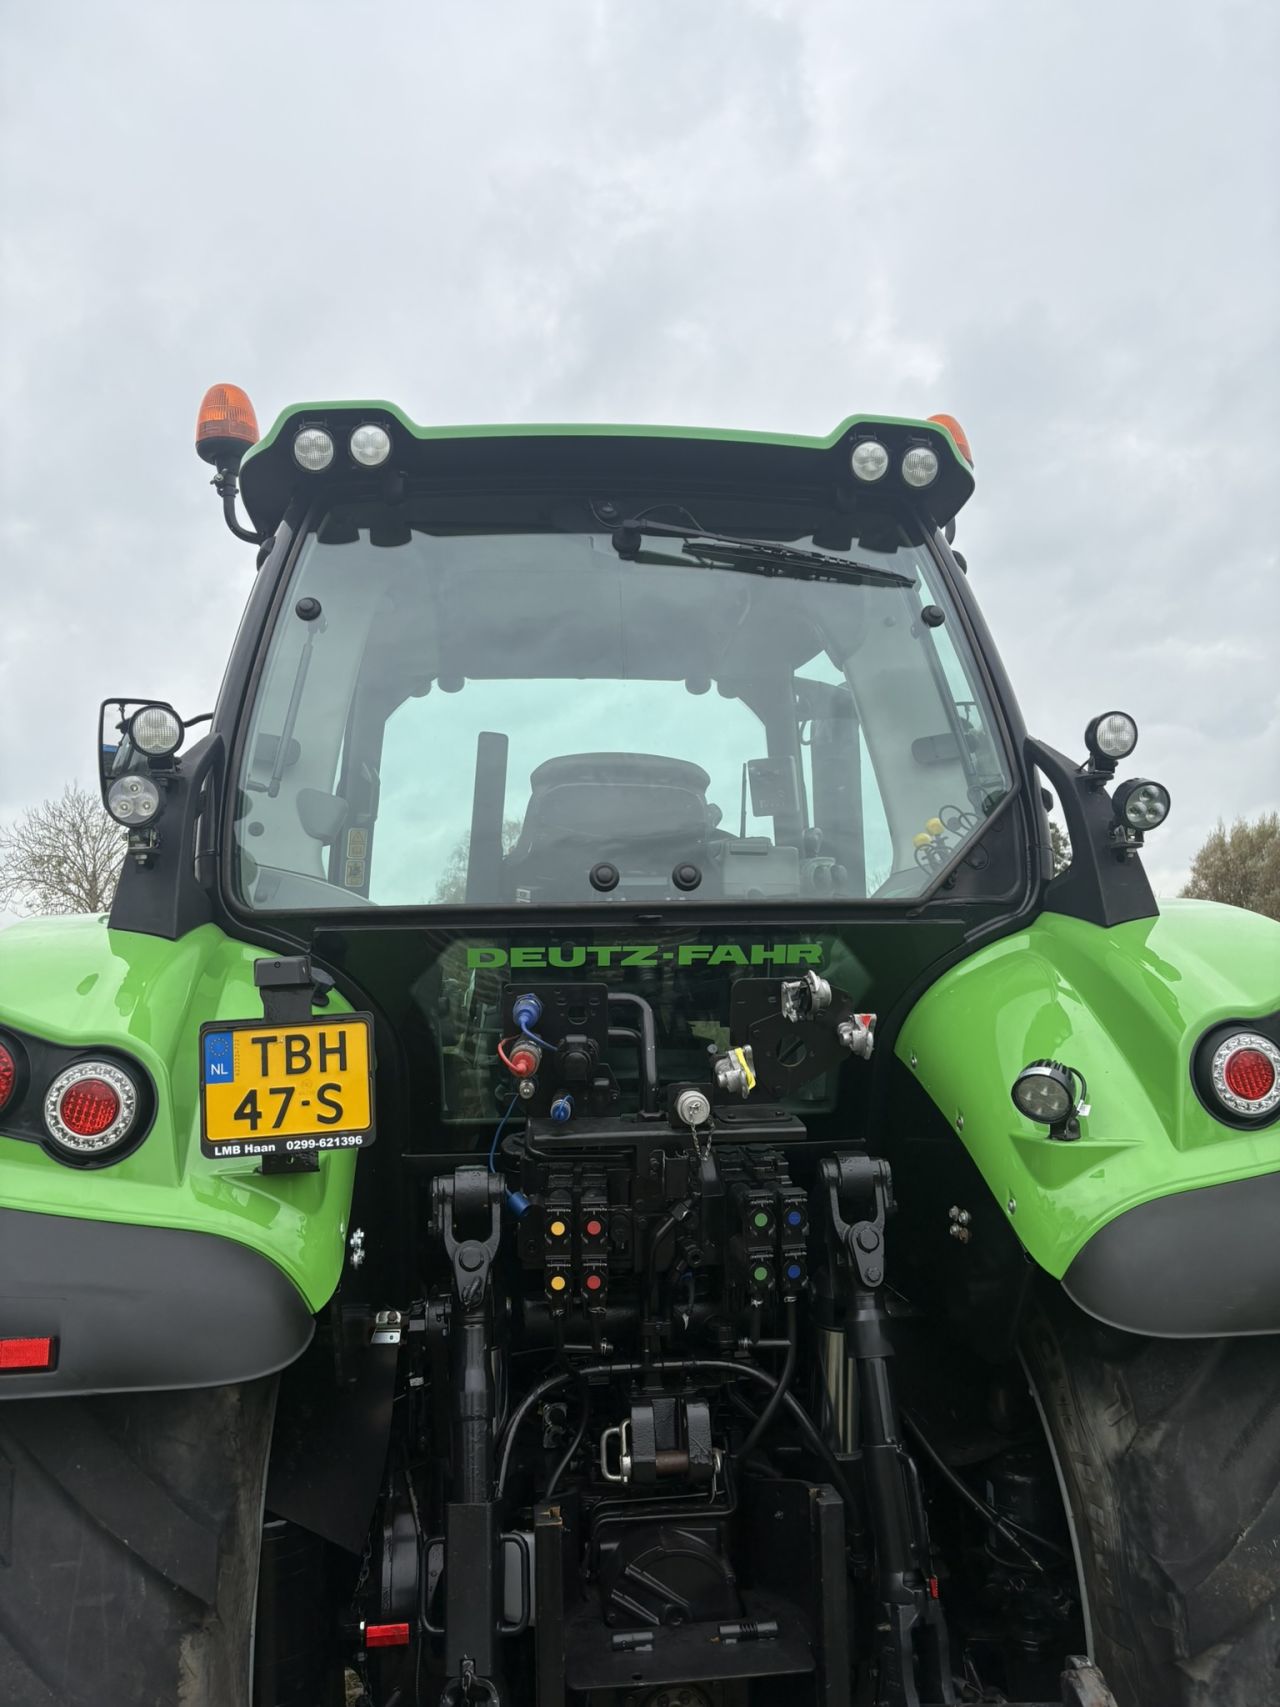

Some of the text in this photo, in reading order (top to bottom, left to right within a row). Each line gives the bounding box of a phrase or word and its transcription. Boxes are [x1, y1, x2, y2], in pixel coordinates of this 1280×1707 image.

[467, 944, 822, 968] DEUTZ-FAHR
[251, 1030, 347, 1077] TBH
[210, 1063, 228, 1075] NL
[233, 1082, 343, 1131] 47-S
[214, 1135, 363, 1156] LMB Haan 0299-621396
